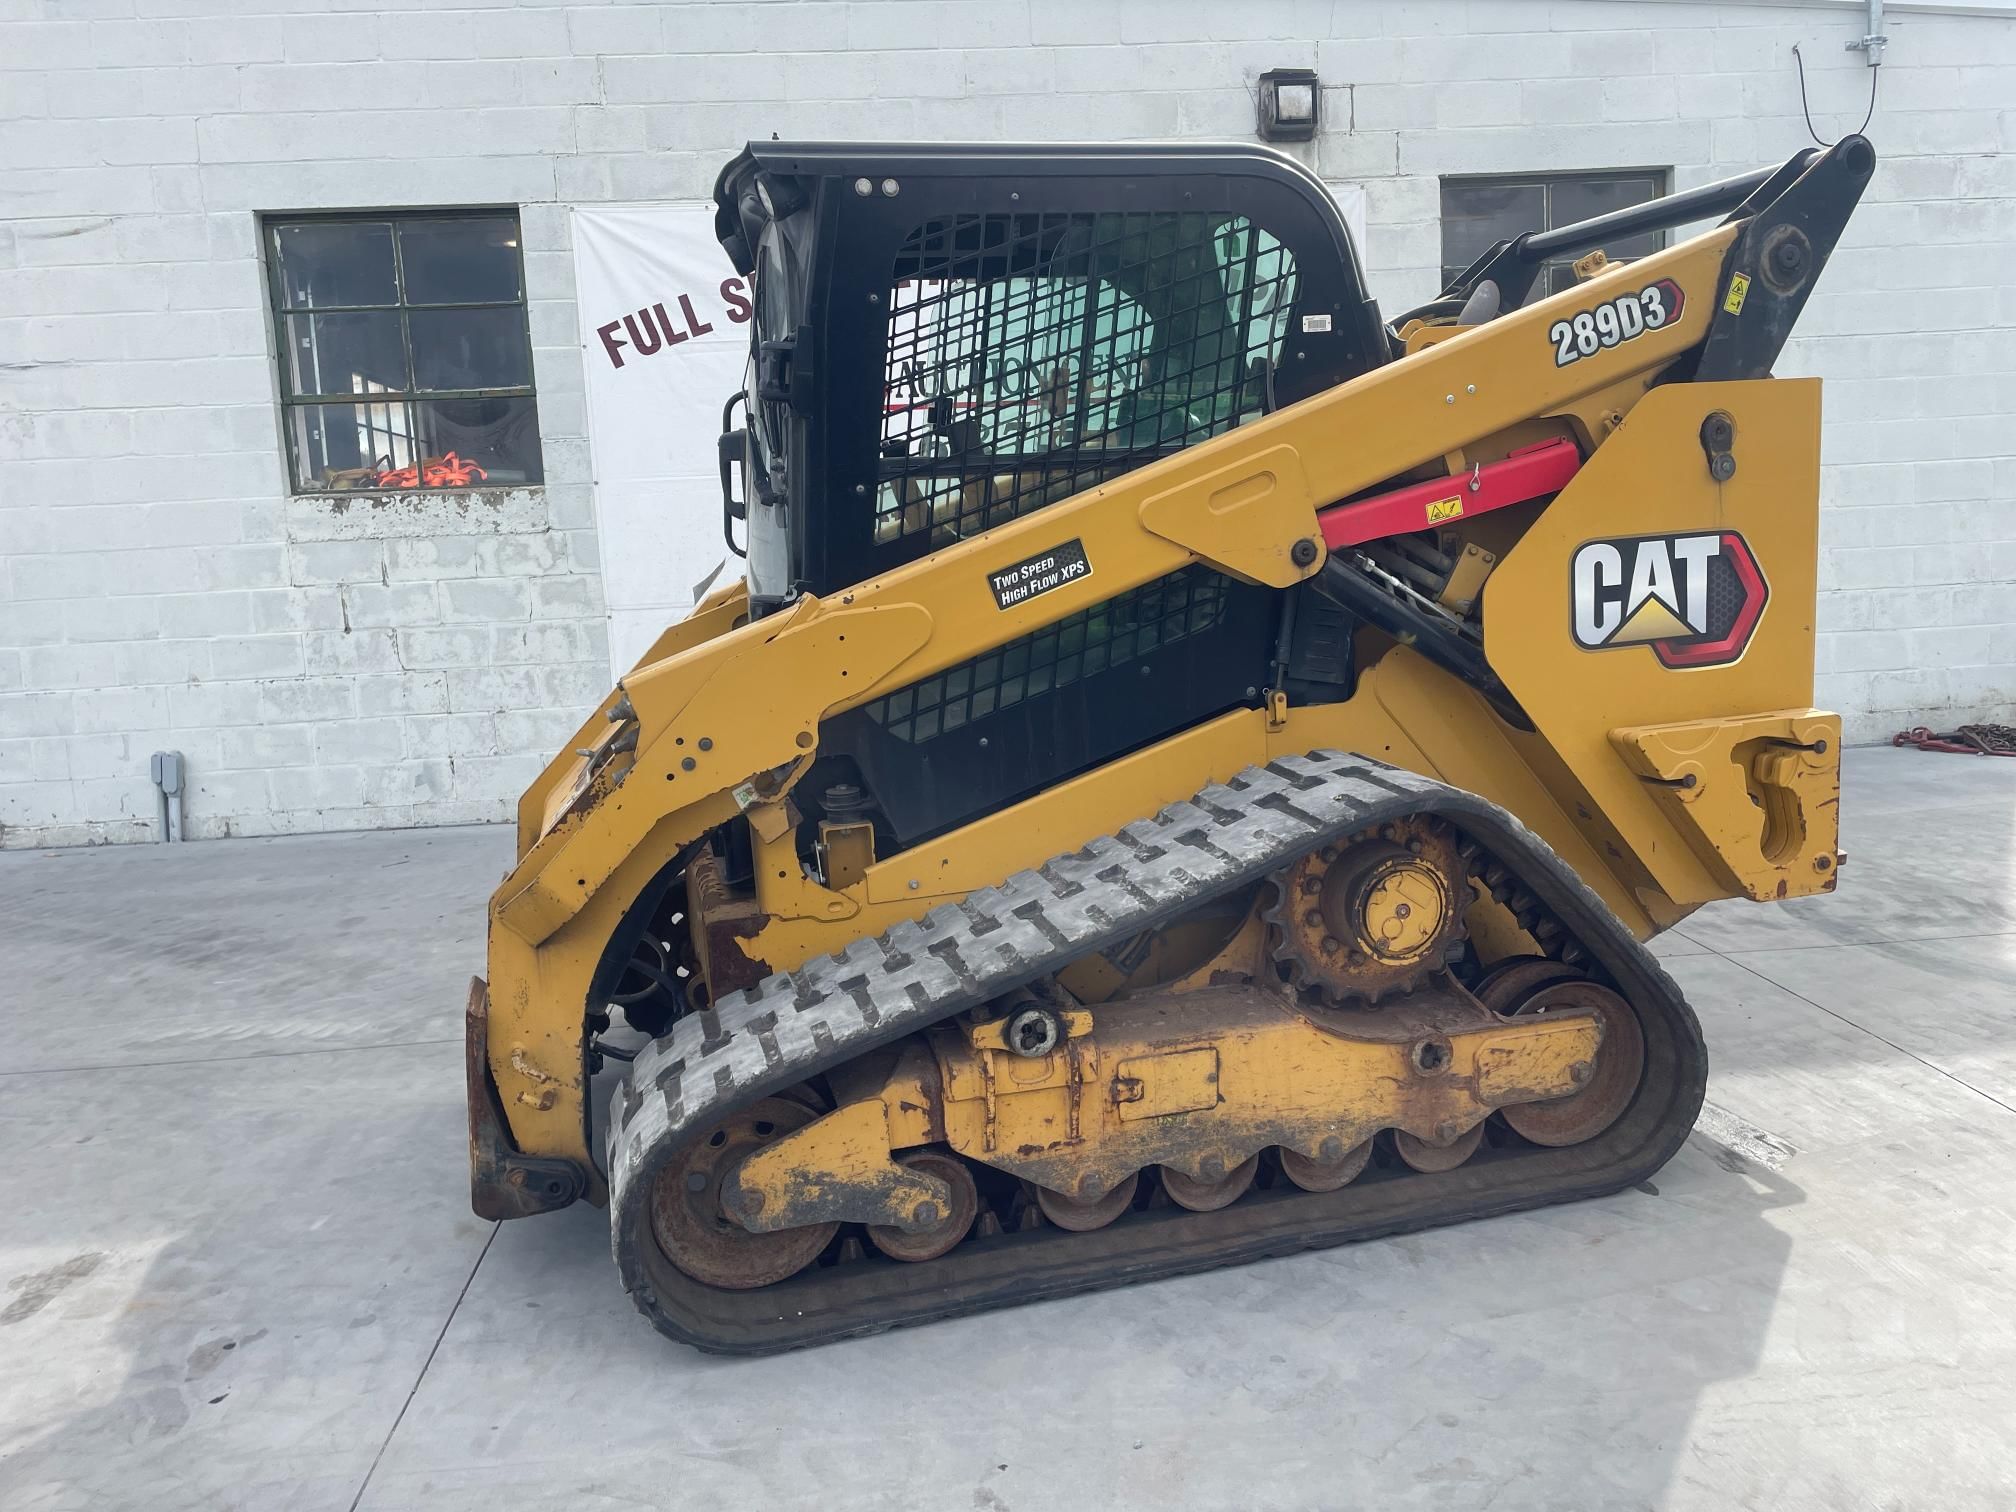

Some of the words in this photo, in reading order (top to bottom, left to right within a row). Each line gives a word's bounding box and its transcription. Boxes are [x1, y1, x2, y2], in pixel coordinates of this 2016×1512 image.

[597, 293, 714, 369] FULL
[720, 273, 756, 324] S
[1550, 285, 1667, 366] 289D3
[1061, 560, 1085, 581] XPS
[1574, 535, 1720, 646] CAT
